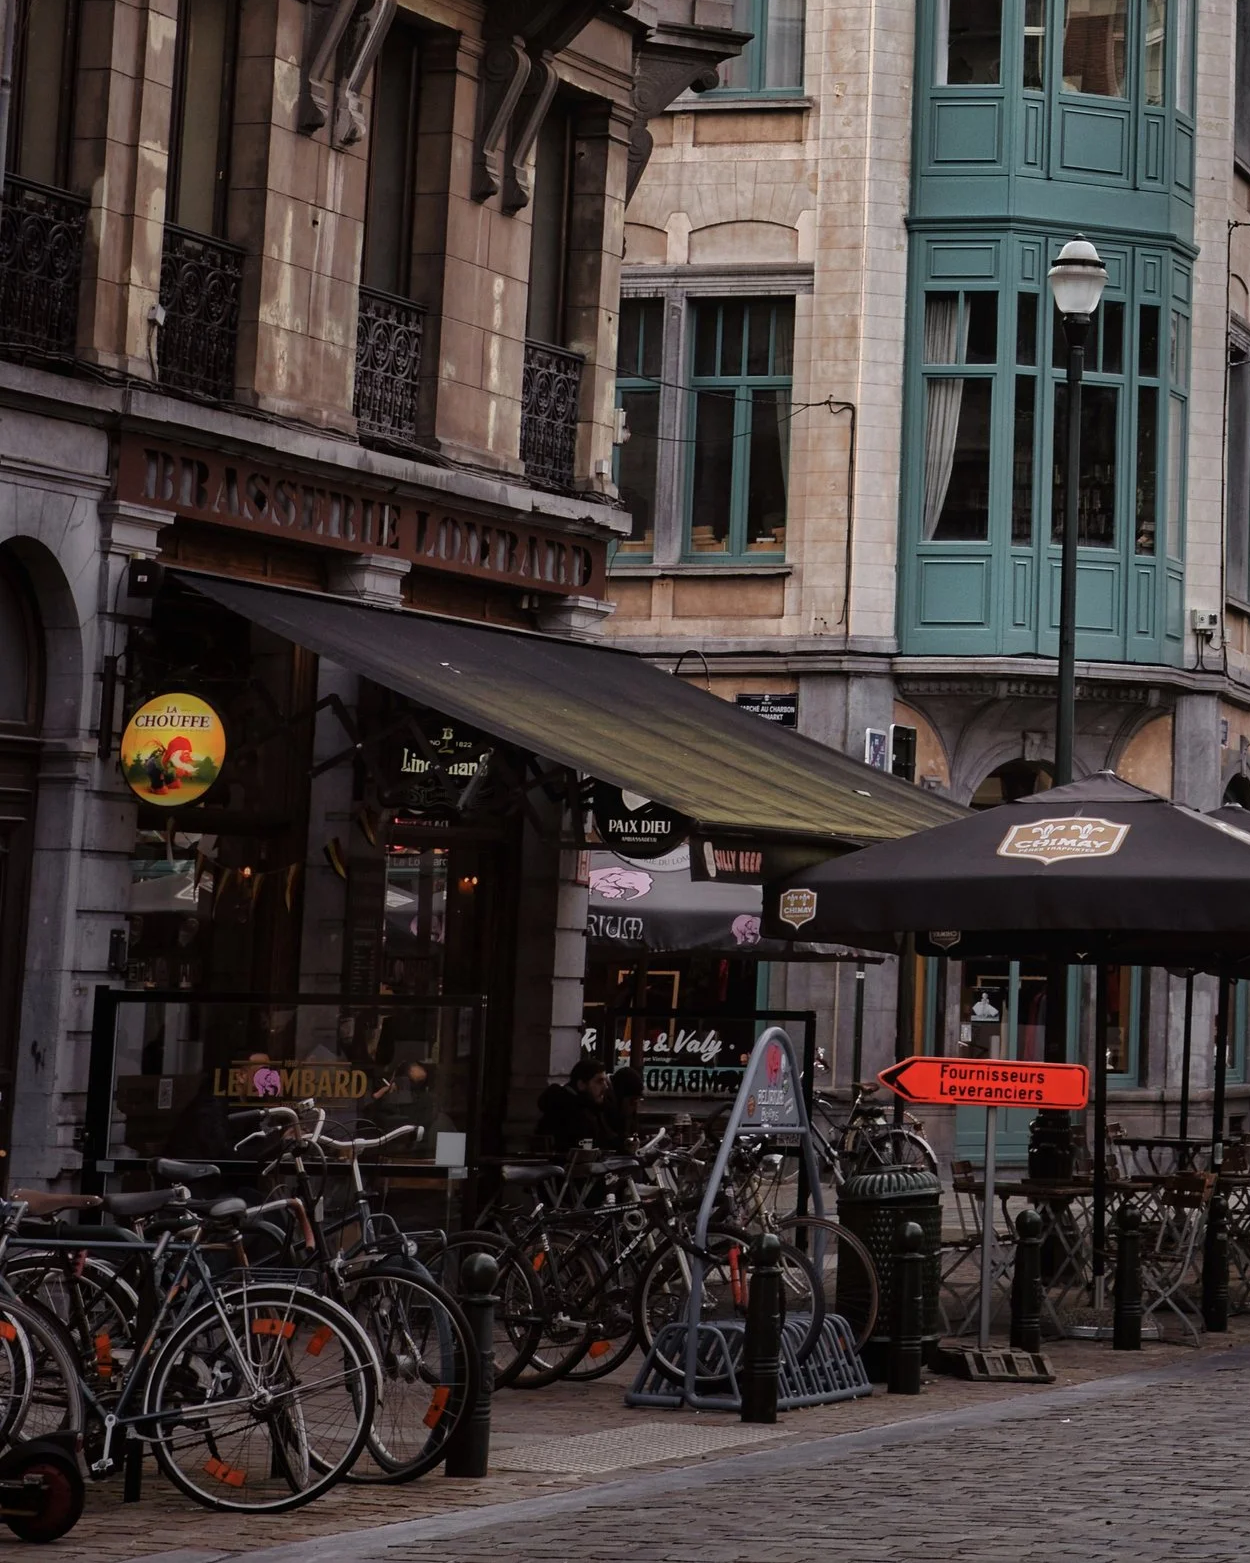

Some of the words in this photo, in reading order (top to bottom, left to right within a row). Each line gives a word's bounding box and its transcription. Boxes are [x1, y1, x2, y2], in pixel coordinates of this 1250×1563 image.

[143, 449, 399, 547] BRASSERIE
[414, 509, 594, 587] LOMBARD
[166, 706, 178, 714] LA
[740, 705, 760, 713] ARCHÉ
[770, 706, 796, 714] CHARBON
[135, 715, 211, 729] CHOUFFE
[641, 820, 672, 834] DIEU
[1014, 838, 1110, 849] CHIMAY
[659, 858, 671, 867] DU
[714, 849, 737, 872] SILLY
[739, 851, 762, 873] BEER
[784, 906, 813, 914] CHIMAY
[653, 1032, 670, 1052] &
[673, 1029, 723, 1063] Valy
[213, 1067, 239, 1097] LE
[940, 1063, 1045, 1084] Fournisseurs
[940, 1081, 1043, 1101] Leveranciers
[613, 1230, 647, 1265] TREK
